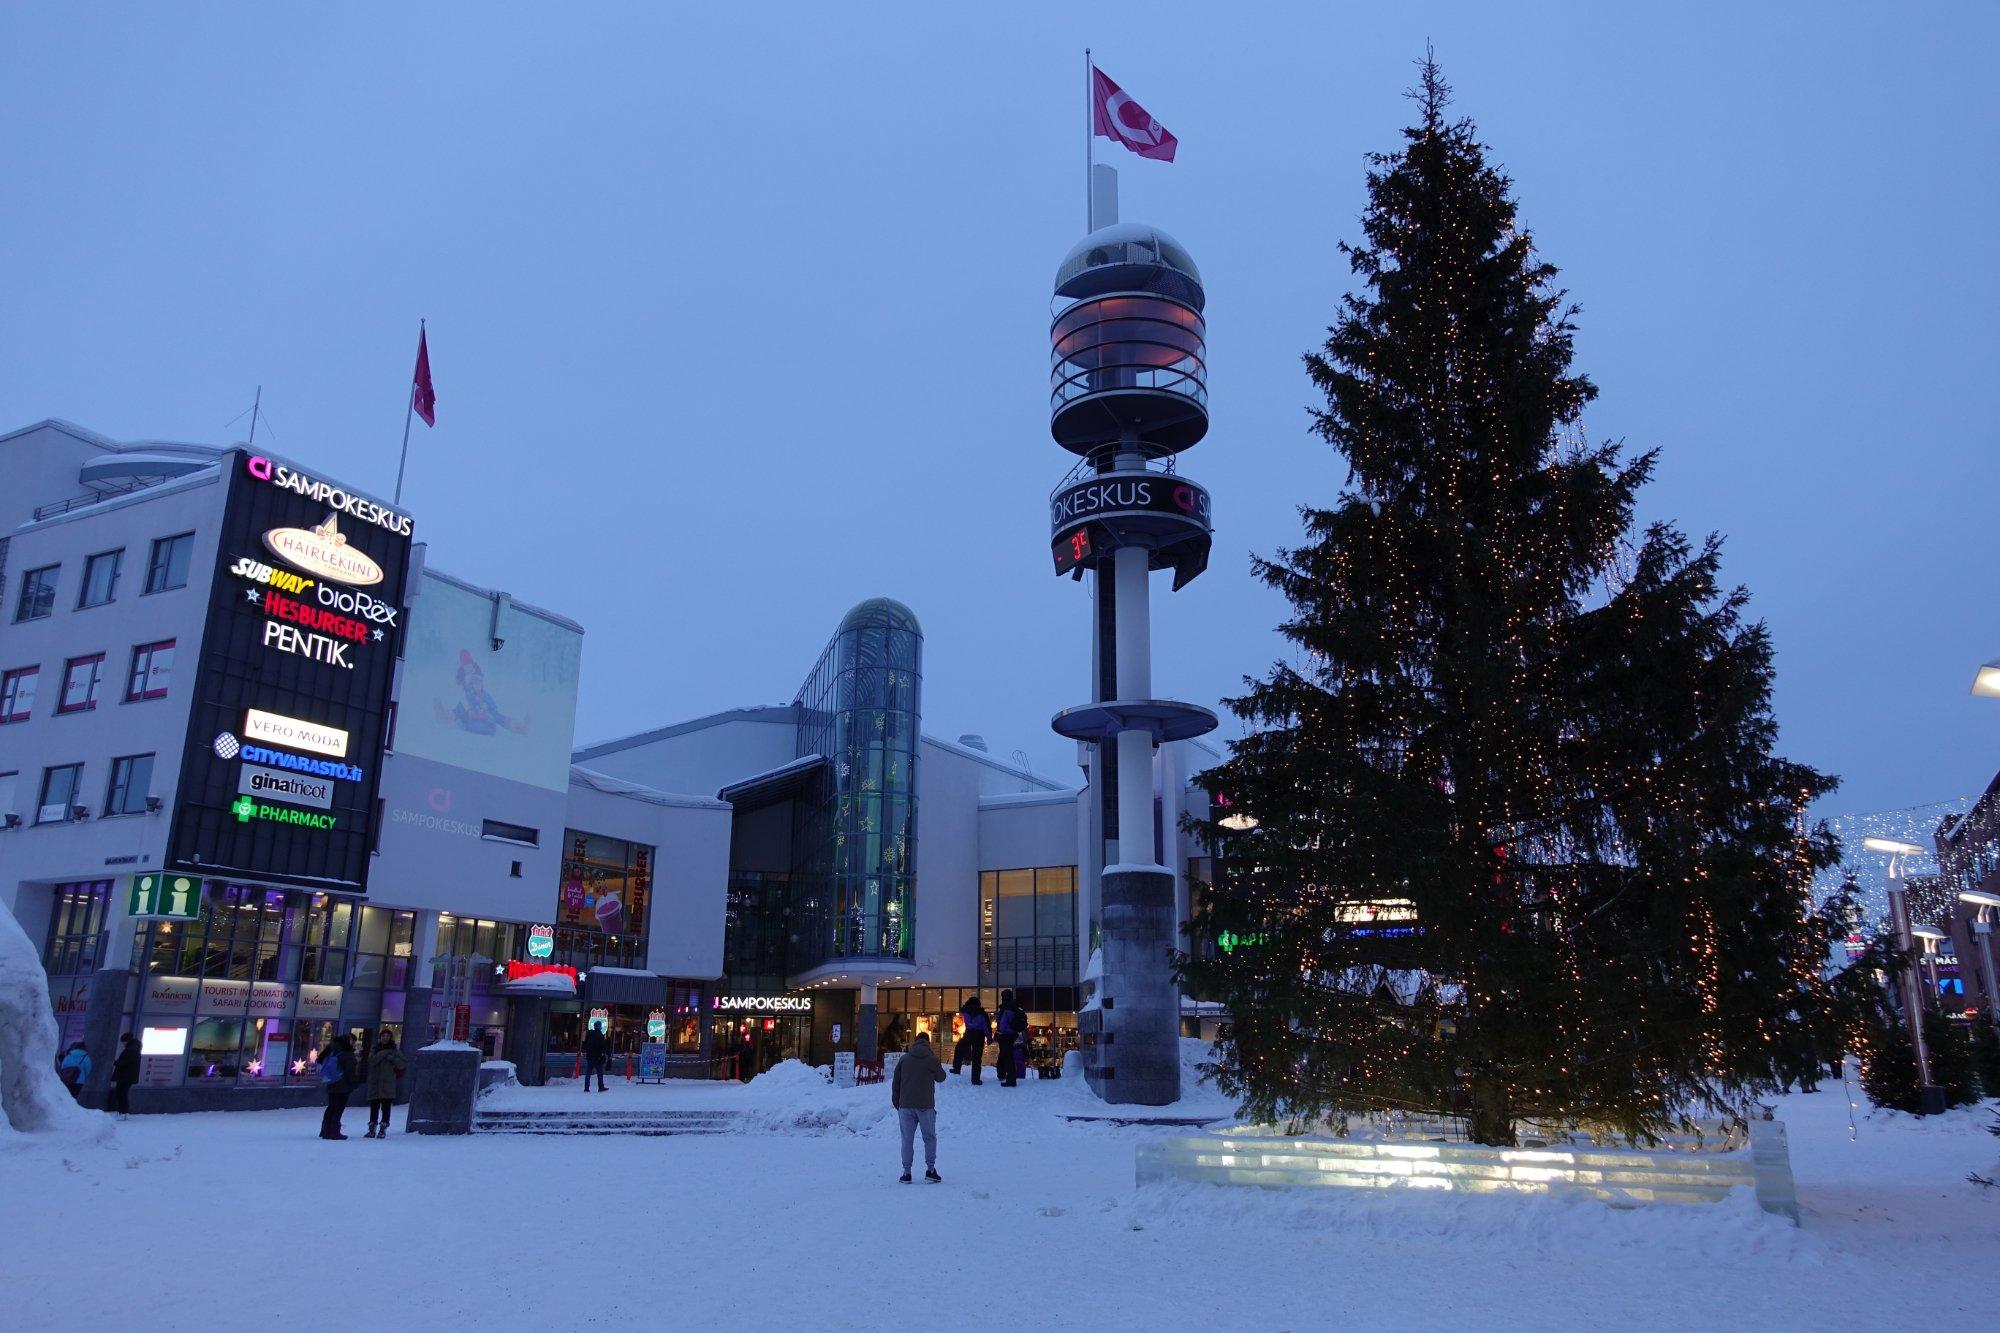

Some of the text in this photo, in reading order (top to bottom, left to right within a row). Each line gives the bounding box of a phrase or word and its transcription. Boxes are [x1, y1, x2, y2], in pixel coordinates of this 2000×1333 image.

[273, 466, 412, 537] SAMPOKESKUS
[284, 537, 371, 577] HAIRLEKIINI
[230, 557, 315, 594] SUBWAY
[265, 590, 368, 646] HESBURGER
[253, 719, 341, 749] VERO MODA
[260, 804, 336, 830] PHARMACY
[391, 808, 480, 838] SAMPOKESKUS
[203, 986, 238, 996] TOURIST
[212, 998, 287, 1009] SAFARI BOOKINGS
[720, 996, 811, 1010] SAMPOKESKUS
